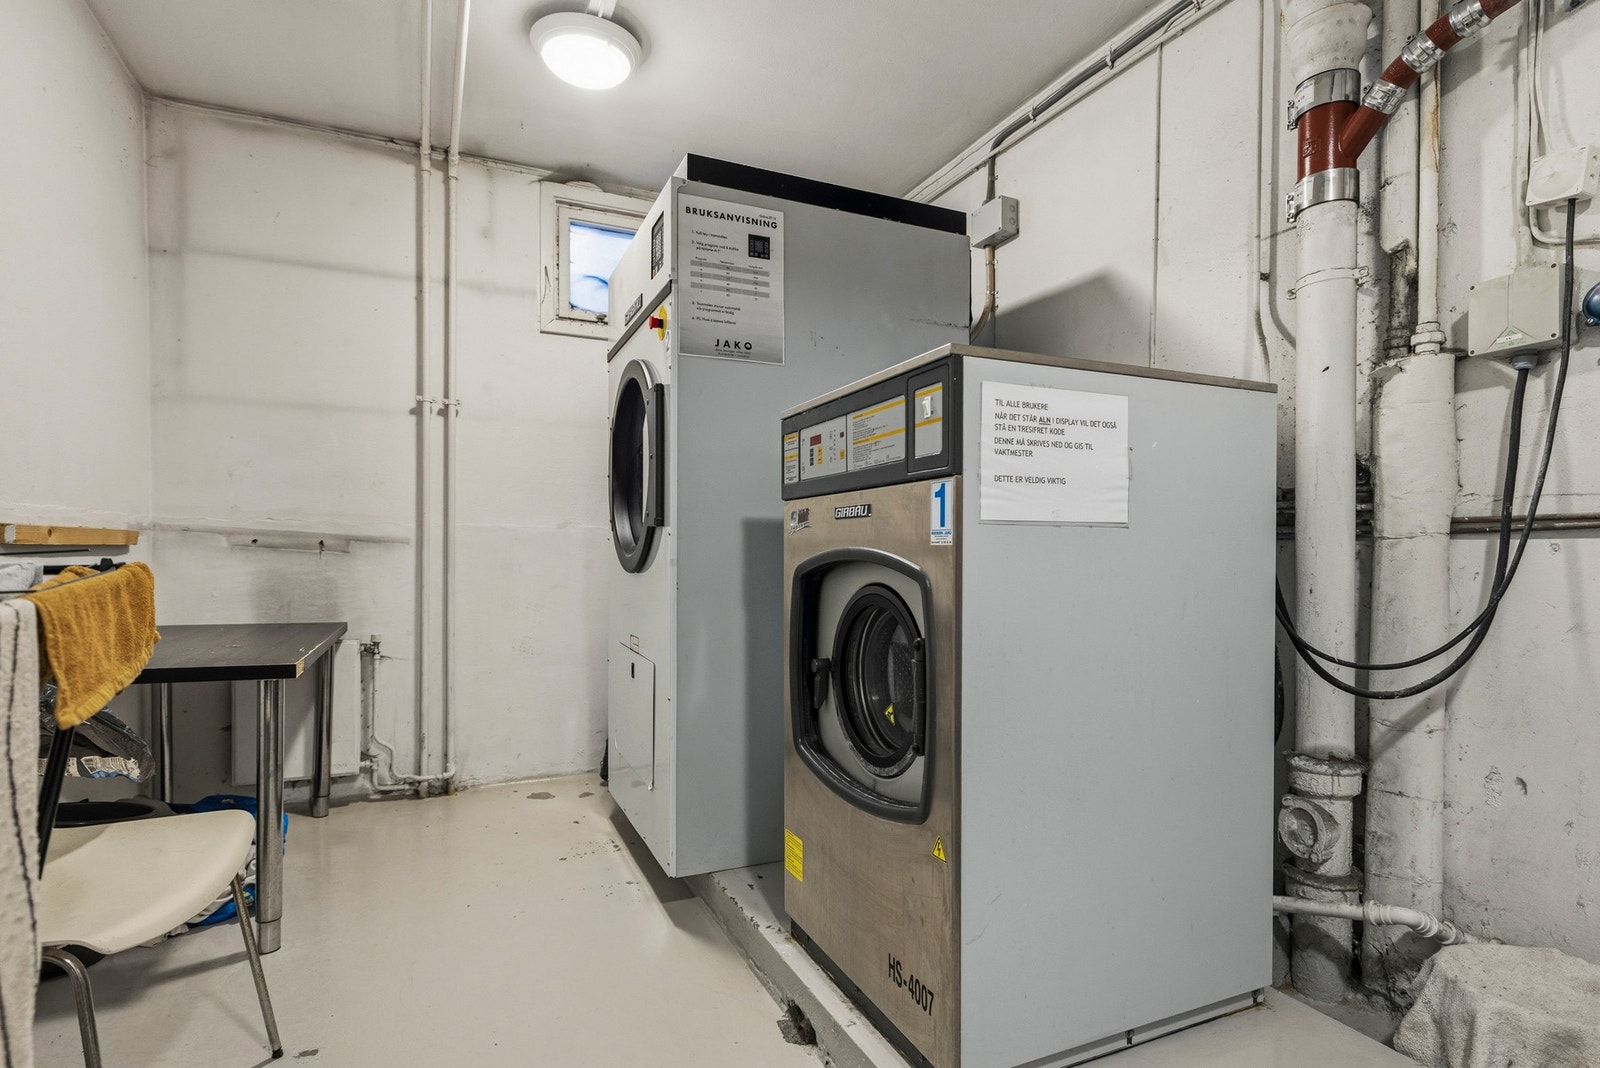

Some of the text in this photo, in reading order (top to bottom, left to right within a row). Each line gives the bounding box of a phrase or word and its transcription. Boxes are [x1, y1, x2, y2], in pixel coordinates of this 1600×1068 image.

[685, 206, 778, 229] BRUKSANVISNING
[714, 339, 753, 351] JAKO
[994, 398, 1049, 411] TIL ALLE BRUKERE
[994, 411, 1008, 421] NÅR
[1010, 413, 1021, 422] DET
[1022, 413, 1038, 423] STÅR
[1038, 416, 1051, 425] ALN
[1056, 417, 1079, 427] DISPLAY
[1080, 419, 1089, 428] VIL
[1102, 420, 1118, 429] OGSÅ
[994, 423, 1007, 432] STÅ
[1018, 425, 1048, 435] TRESIFRET
[1050, 427, 1065, 436] KODE
[994, 437, 1015, 446] DENNE
[1016, 437, 1026, 446] MÅ
[1026, 439, 1050, 448] SKRIVES
[1050, 440, 1063, 449] NED
[1064, 441, 1073, 450] OG
[1084, 442, 1094, 451] TIL
[994, 448, 1033, 458] VAKTMESTER
[994, 474, 1067, 486] DETTE ER VELDIG VIKTIG
[934, 482, 946, 528] 1
[888, 952, 935, 1017] HS-4007
